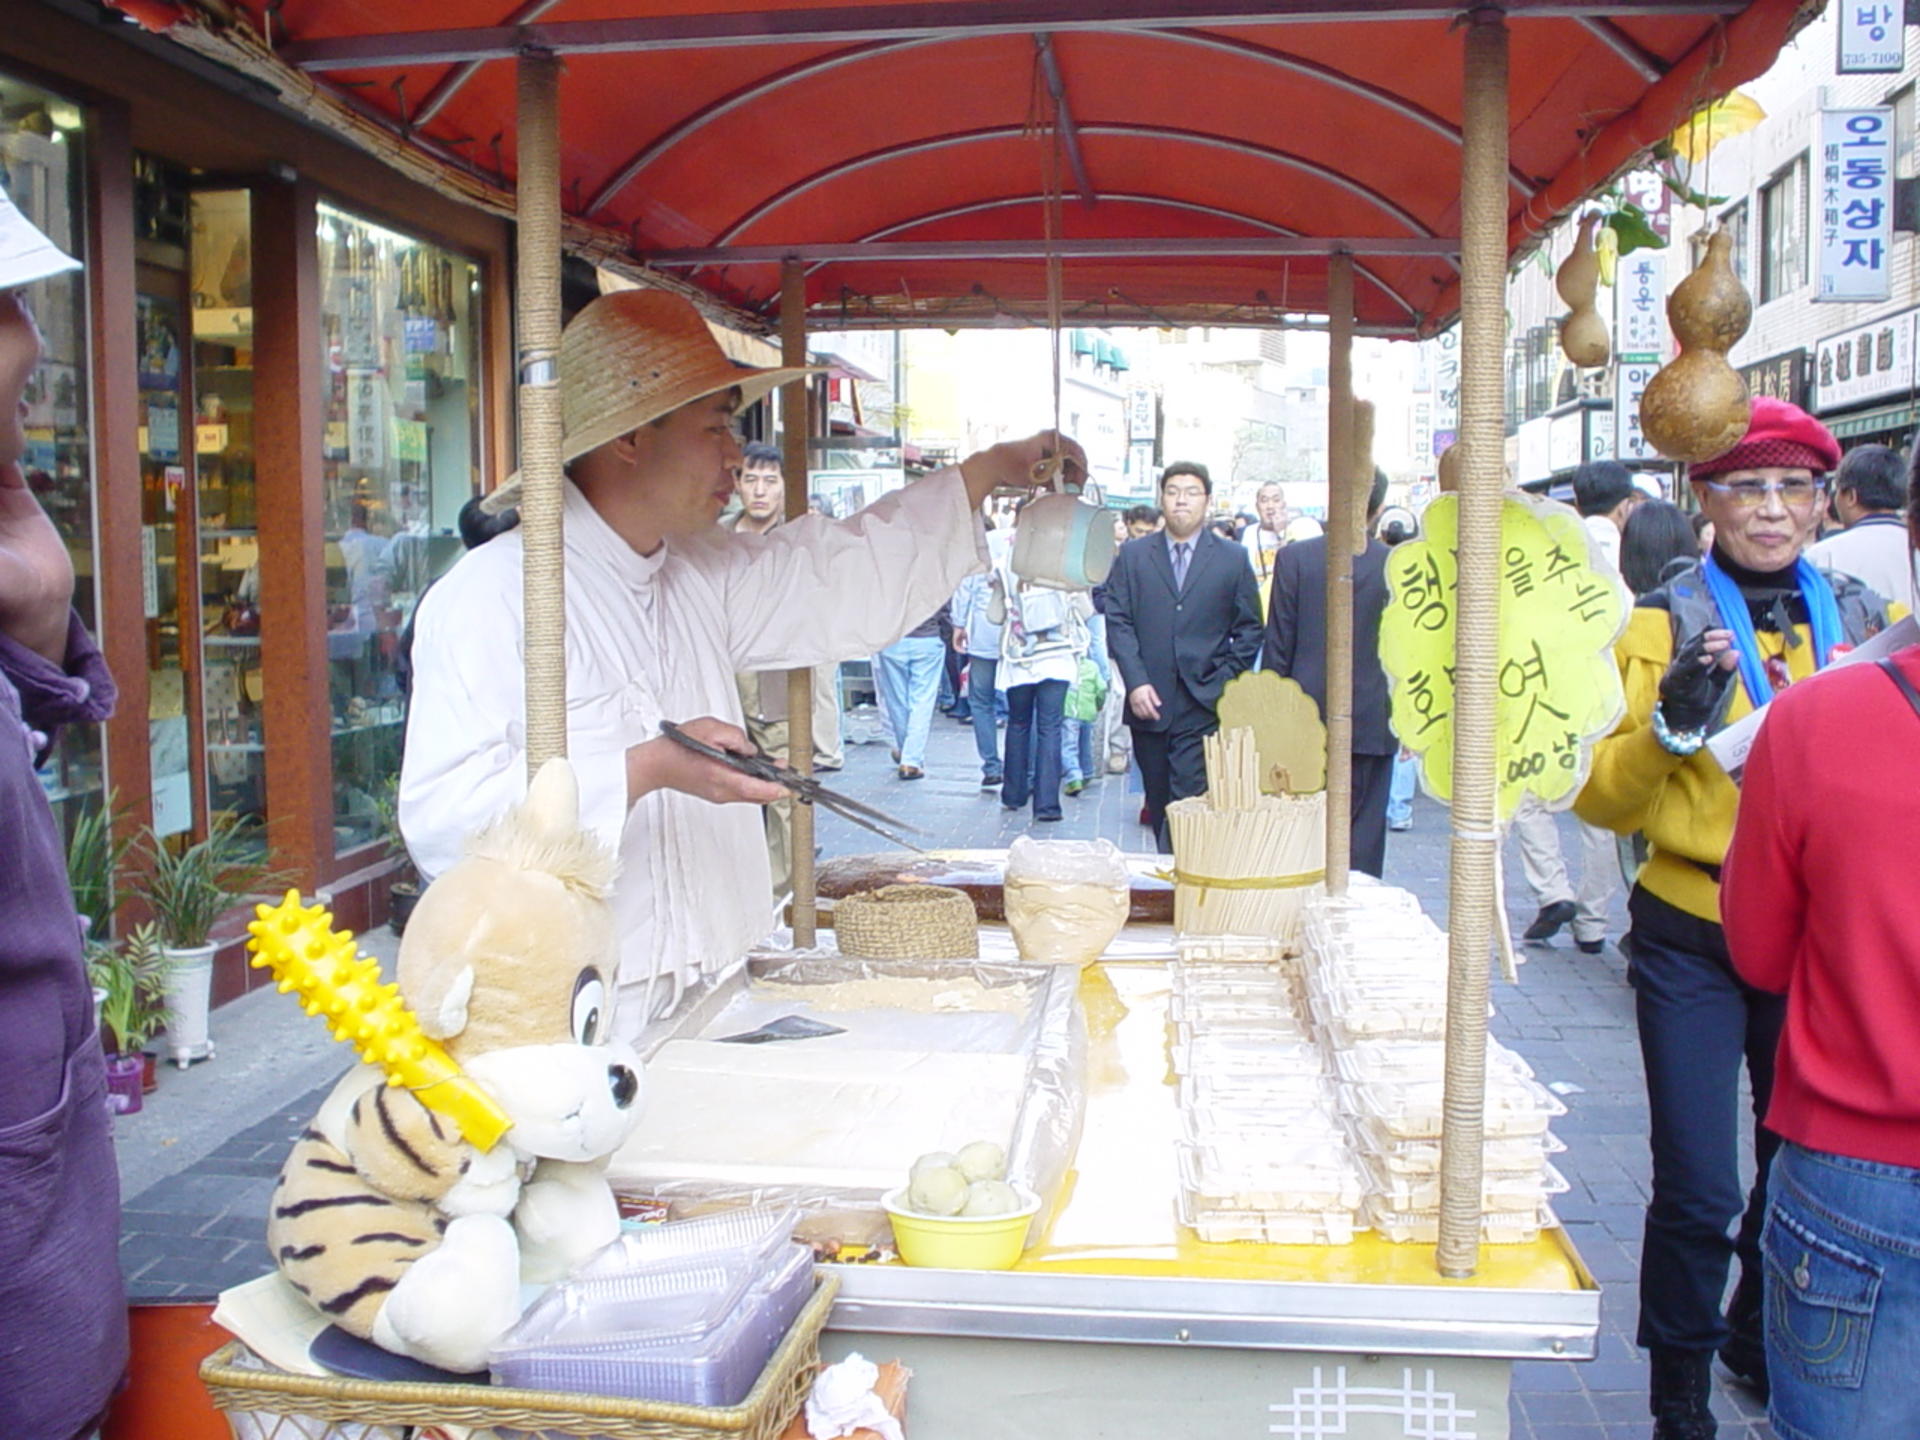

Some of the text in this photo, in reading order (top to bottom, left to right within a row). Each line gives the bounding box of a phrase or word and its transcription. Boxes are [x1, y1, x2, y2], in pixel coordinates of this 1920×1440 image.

[1857, 4, 1893, 42] 방
[1842, 115, 1887, 270] 오동상자
[1543, 544, 1610, 622] 주는
